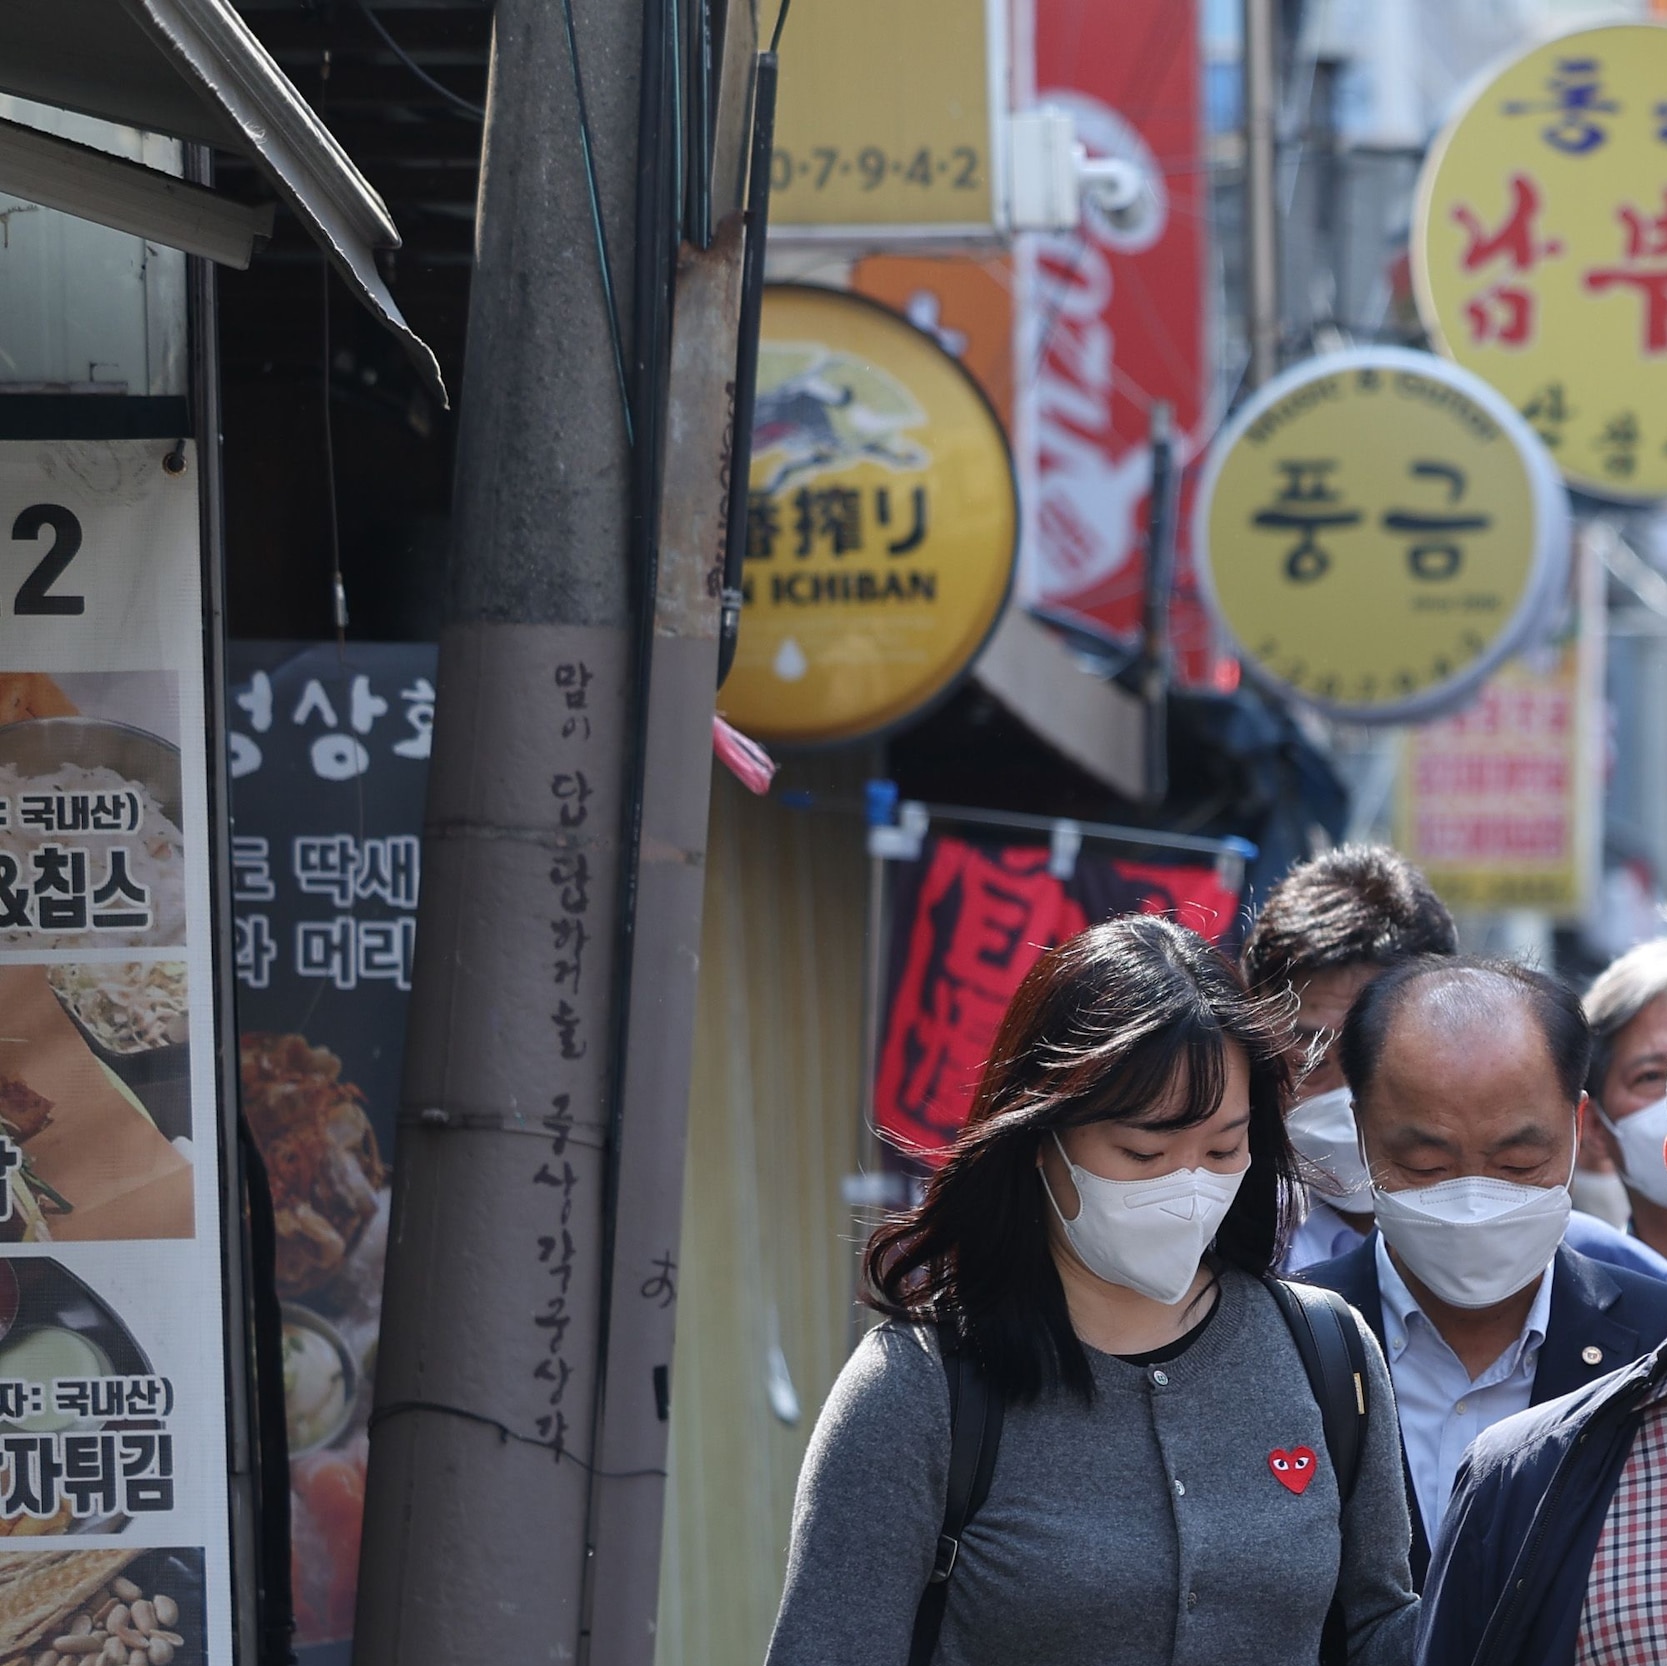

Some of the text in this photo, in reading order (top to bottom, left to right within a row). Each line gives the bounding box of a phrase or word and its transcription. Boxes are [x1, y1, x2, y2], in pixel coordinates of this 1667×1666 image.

[1250, 459, 1490, 583] 풍금
[10, 503, 85, 616] 2
[773, 573, 937, 604] ICHIBAN
[21, 791, 140, 832] 국내산)
[296, 916, 416, 990] 머리
[57, 1377, 173, 1416] 국내산)
[0, 1434, 174, 1514] 자튀김
